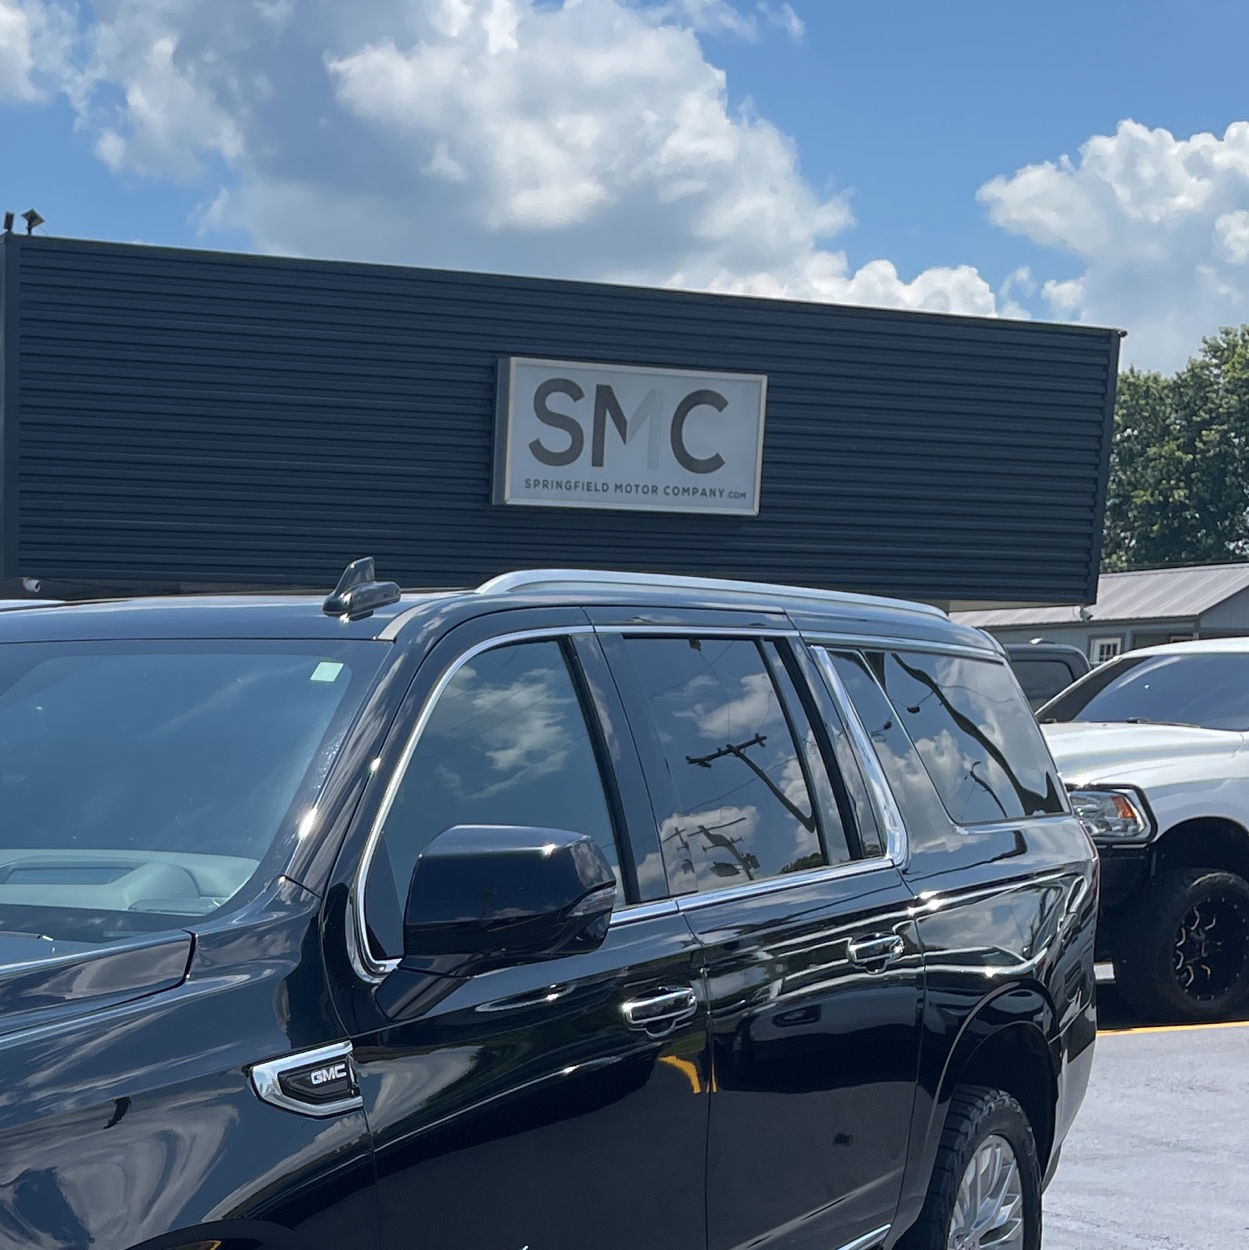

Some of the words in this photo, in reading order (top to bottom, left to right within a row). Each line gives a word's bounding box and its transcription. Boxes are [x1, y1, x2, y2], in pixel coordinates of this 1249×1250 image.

[528, 377, 729, 474] SMC
[524, 478, 610, 493] SPRINGFIELD
[614, 482, 659, 496] MOTOR
[310, 1063, 348, 1085] GMC
